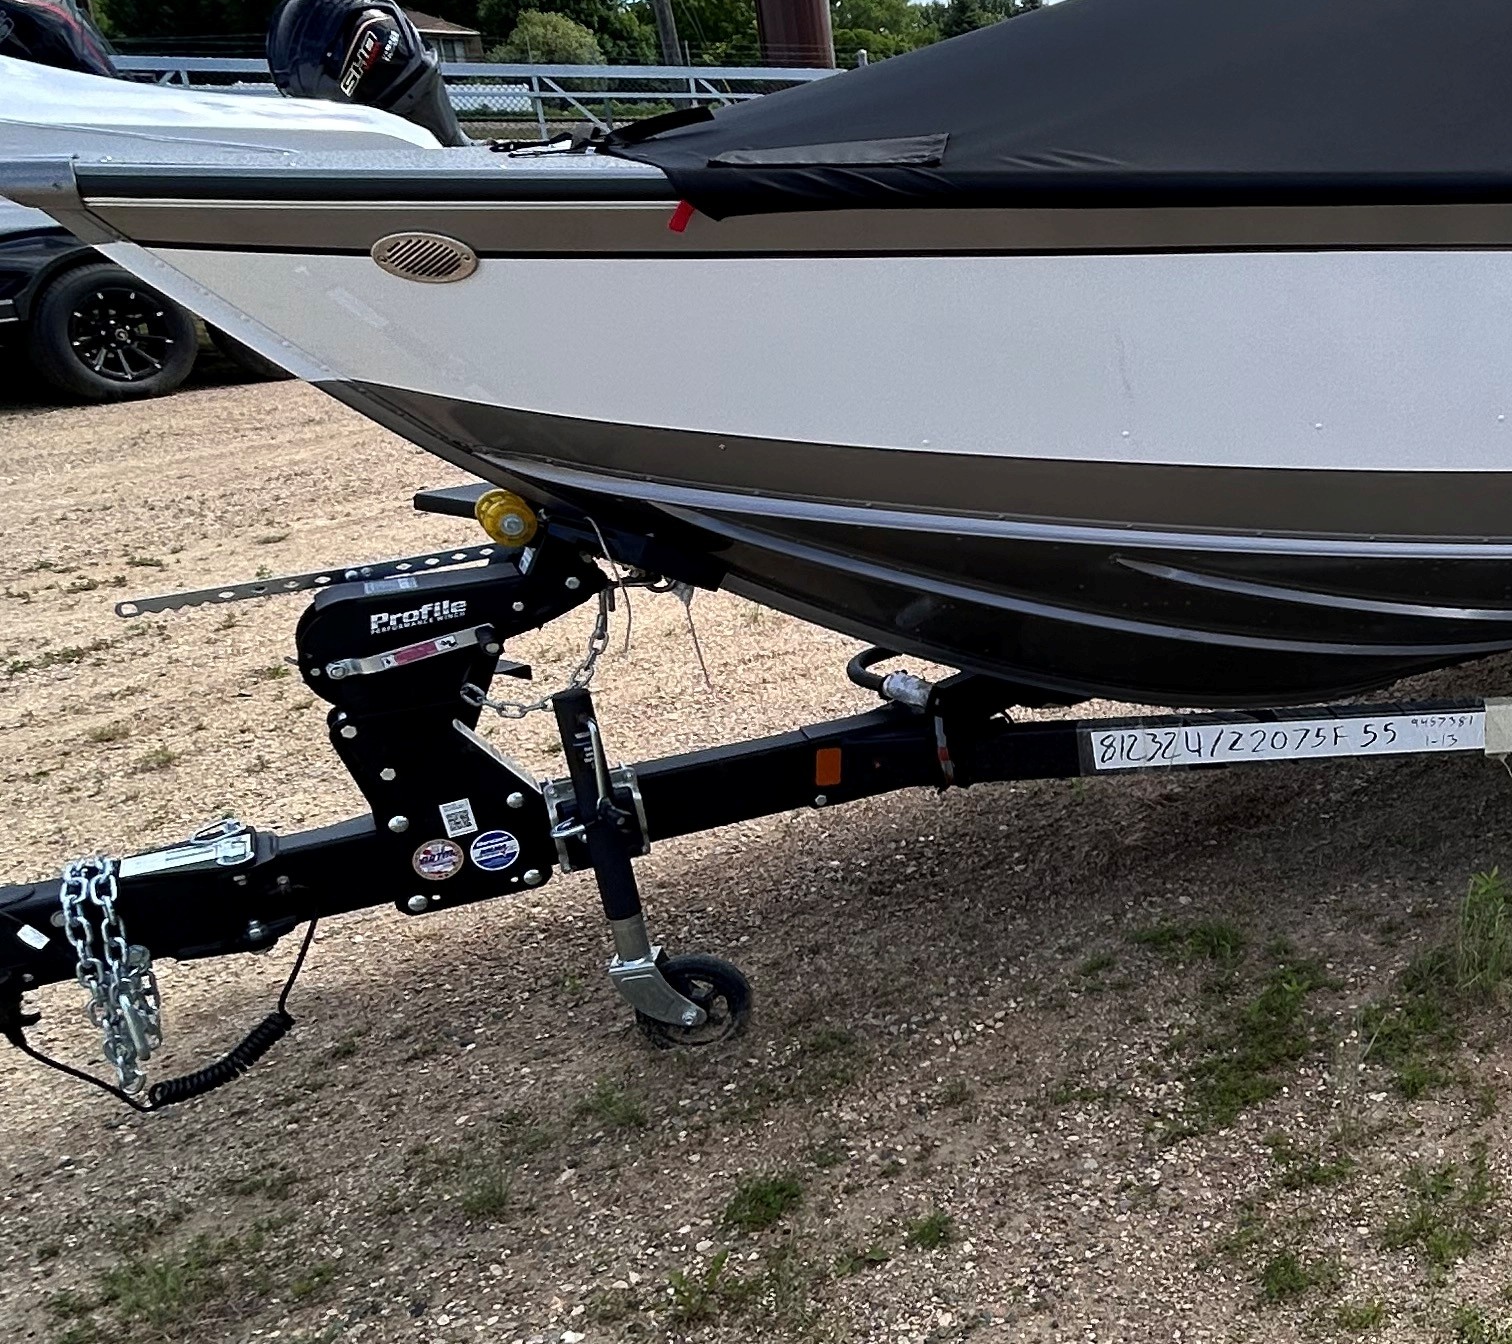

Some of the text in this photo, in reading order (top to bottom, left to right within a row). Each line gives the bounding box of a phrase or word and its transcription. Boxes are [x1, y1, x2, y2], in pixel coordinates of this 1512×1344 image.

[340, 30, 378, 97] SHO
[370, 599, 467, 630] Profile
[1360, 722, 1397, 748] 55
